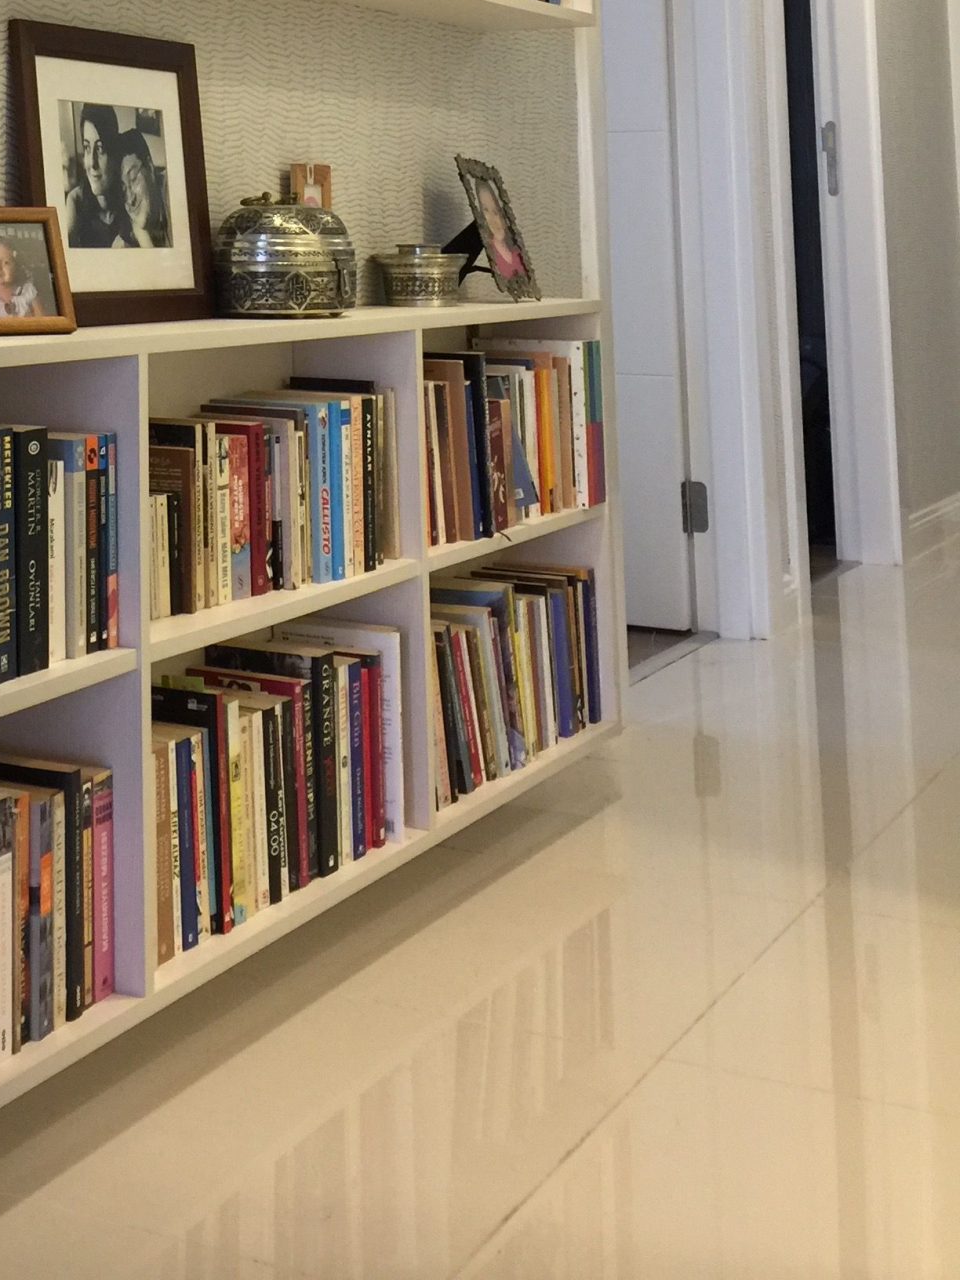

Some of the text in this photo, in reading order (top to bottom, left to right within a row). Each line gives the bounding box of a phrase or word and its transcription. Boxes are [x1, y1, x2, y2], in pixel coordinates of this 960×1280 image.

[27, 471, 36, 536] MARTIN
[320, 487, 331, 556] CALLISTO
[28, 559, 37, 632] OYUNLARI
[352, 682, 360, 704] Bir
